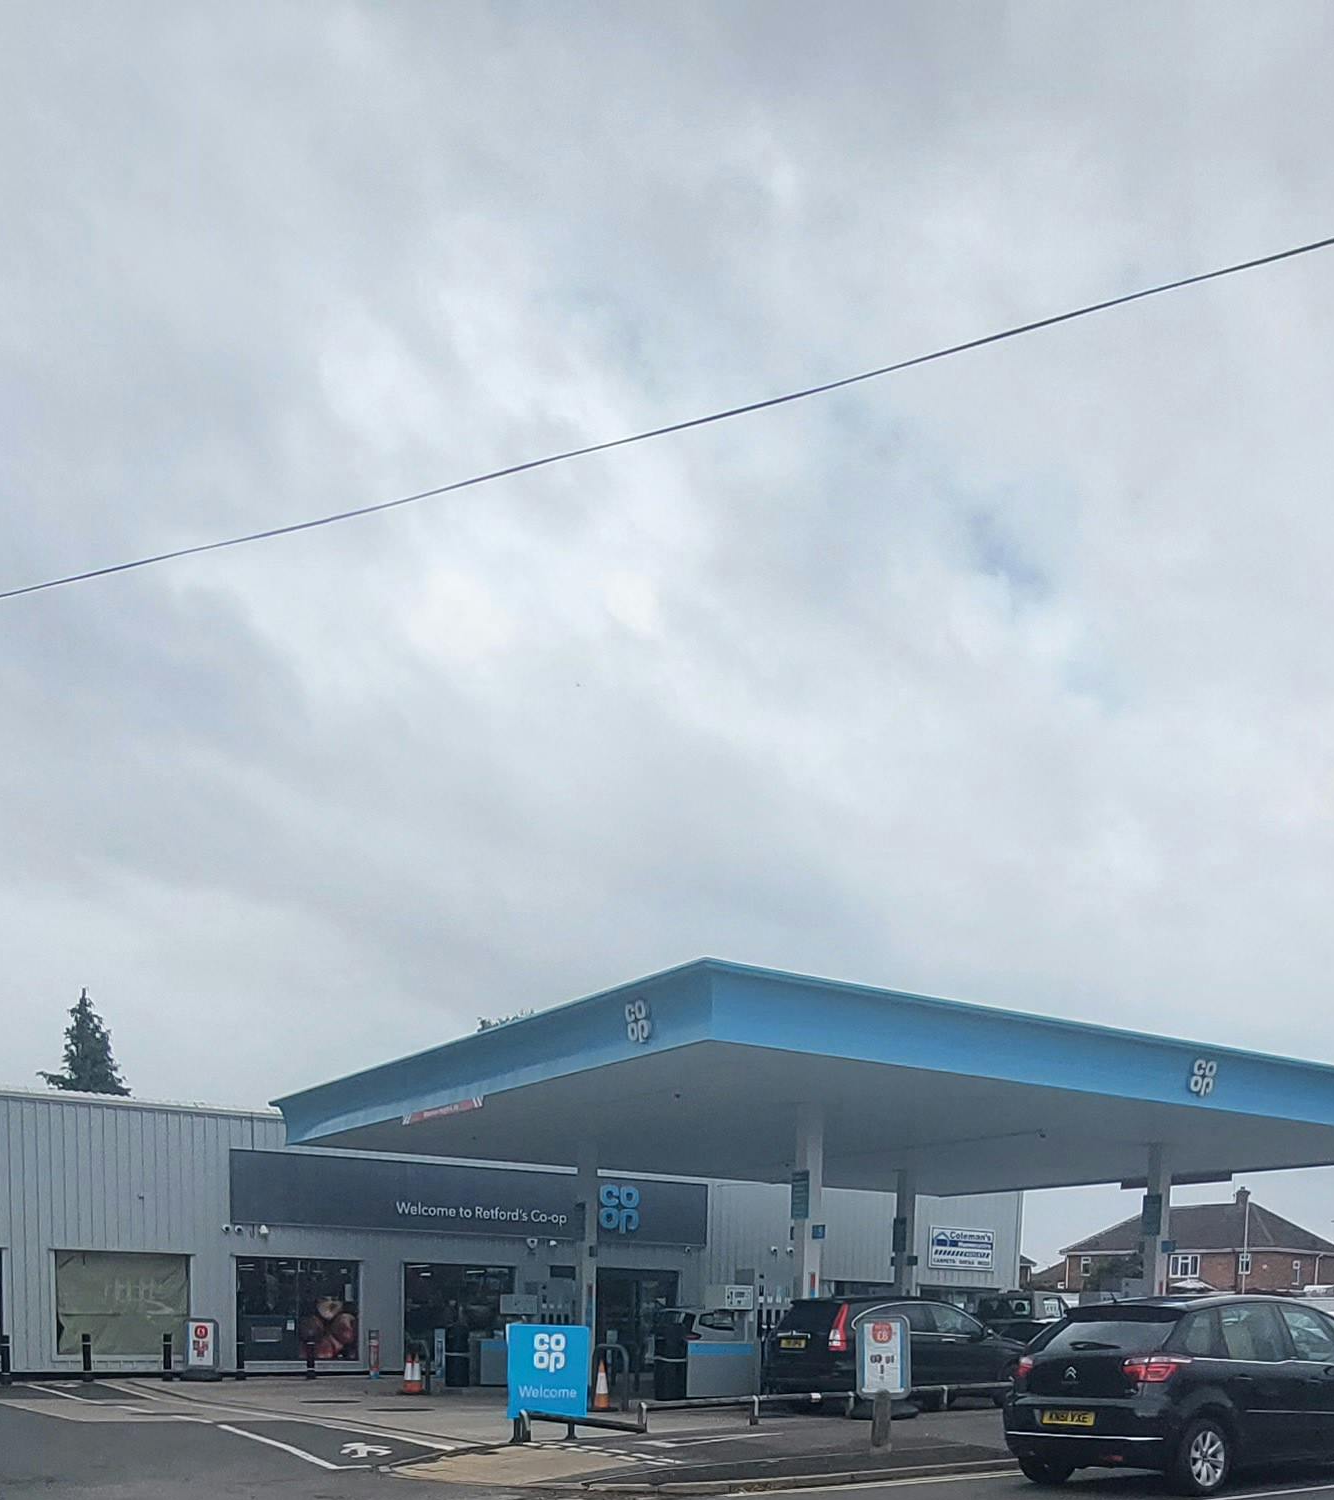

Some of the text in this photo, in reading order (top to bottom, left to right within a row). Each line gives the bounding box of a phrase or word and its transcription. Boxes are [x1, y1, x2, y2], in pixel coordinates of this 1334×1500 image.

[396, 1201, 568, 1227] Welcome to Retford's Co-op
[949, 1231, 991, 1242] Coleman's
[518, 1384, 578, 1399] Welcome
